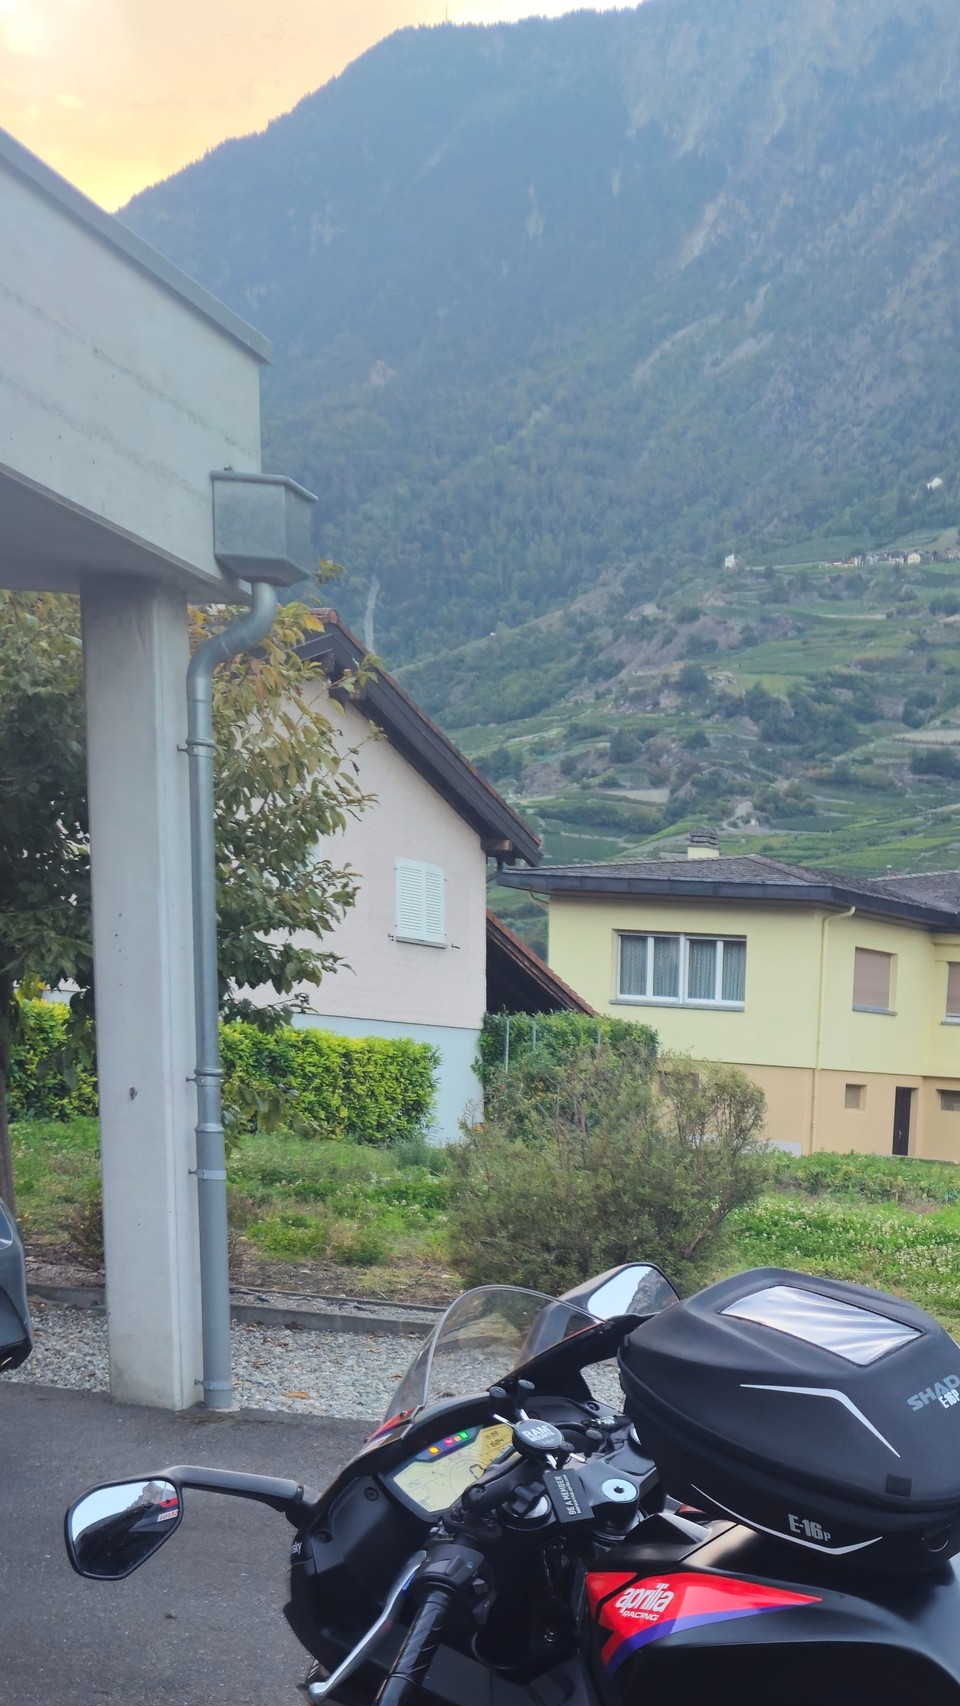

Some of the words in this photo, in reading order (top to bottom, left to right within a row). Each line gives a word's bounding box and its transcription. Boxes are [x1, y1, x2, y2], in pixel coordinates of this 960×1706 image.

[907, 1374, 960, 1412] SHAD
[521, 1425, 552, 1440] RAM
[615, 1583, 675, 1614] aprilia
[622, 1610, 660, 1622] RACING
